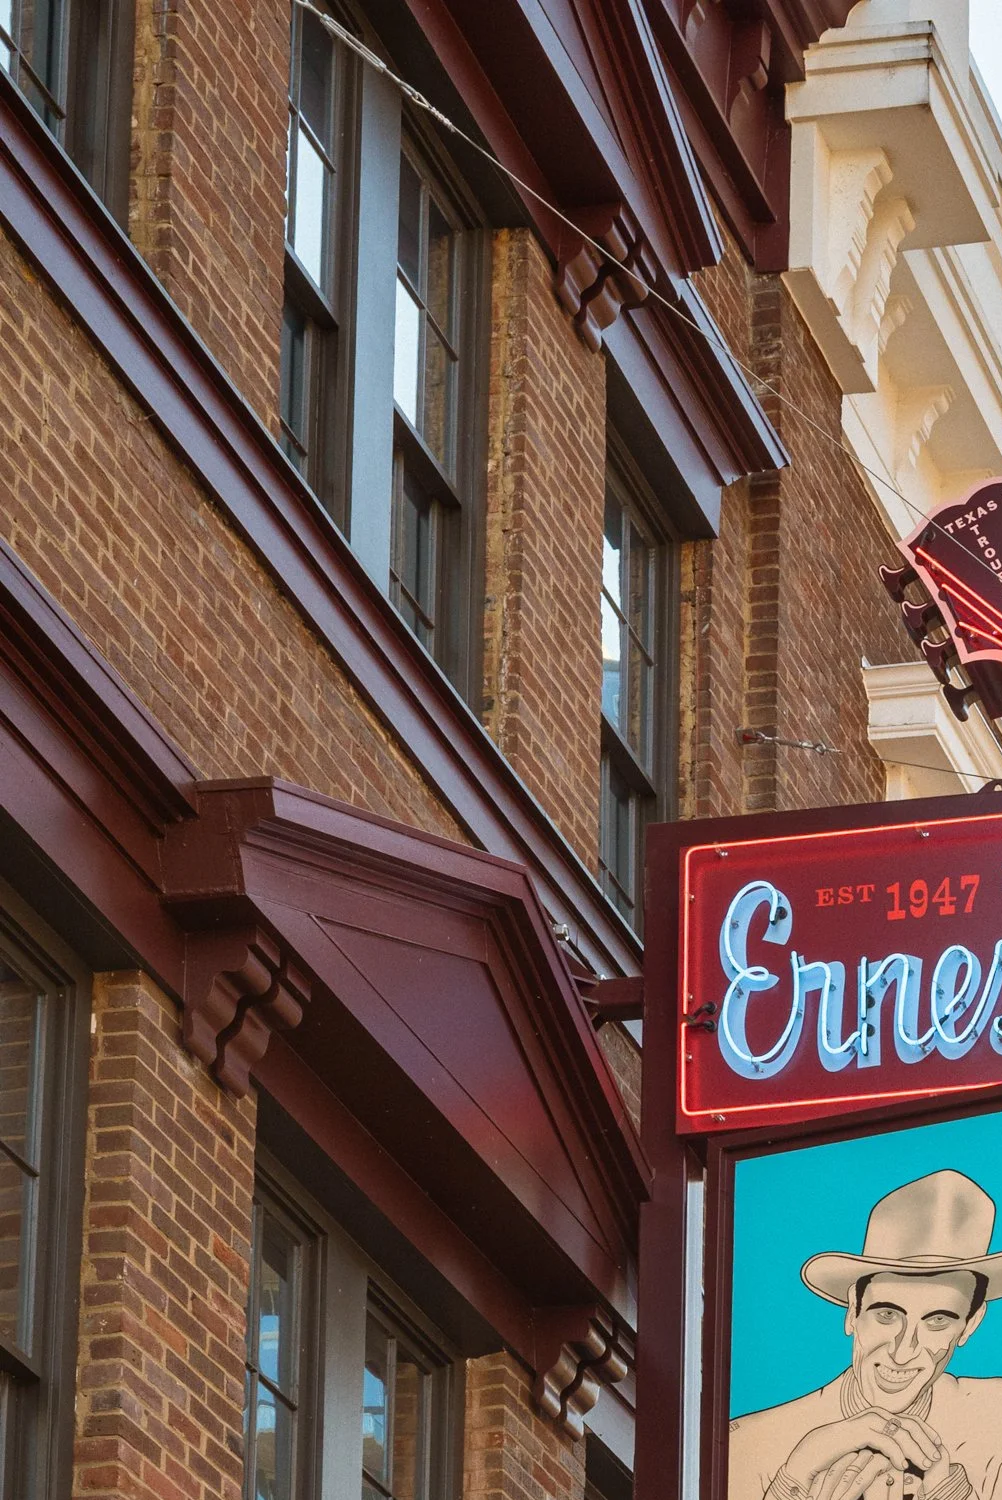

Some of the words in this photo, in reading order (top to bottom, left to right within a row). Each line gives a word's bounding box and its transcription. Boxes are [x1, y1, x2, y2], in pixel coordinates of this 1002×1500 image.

[944, 500, 998, 534] TEXAS
[815, 884, 875, 907] EST
[885, 874, 981, 921] 1947
